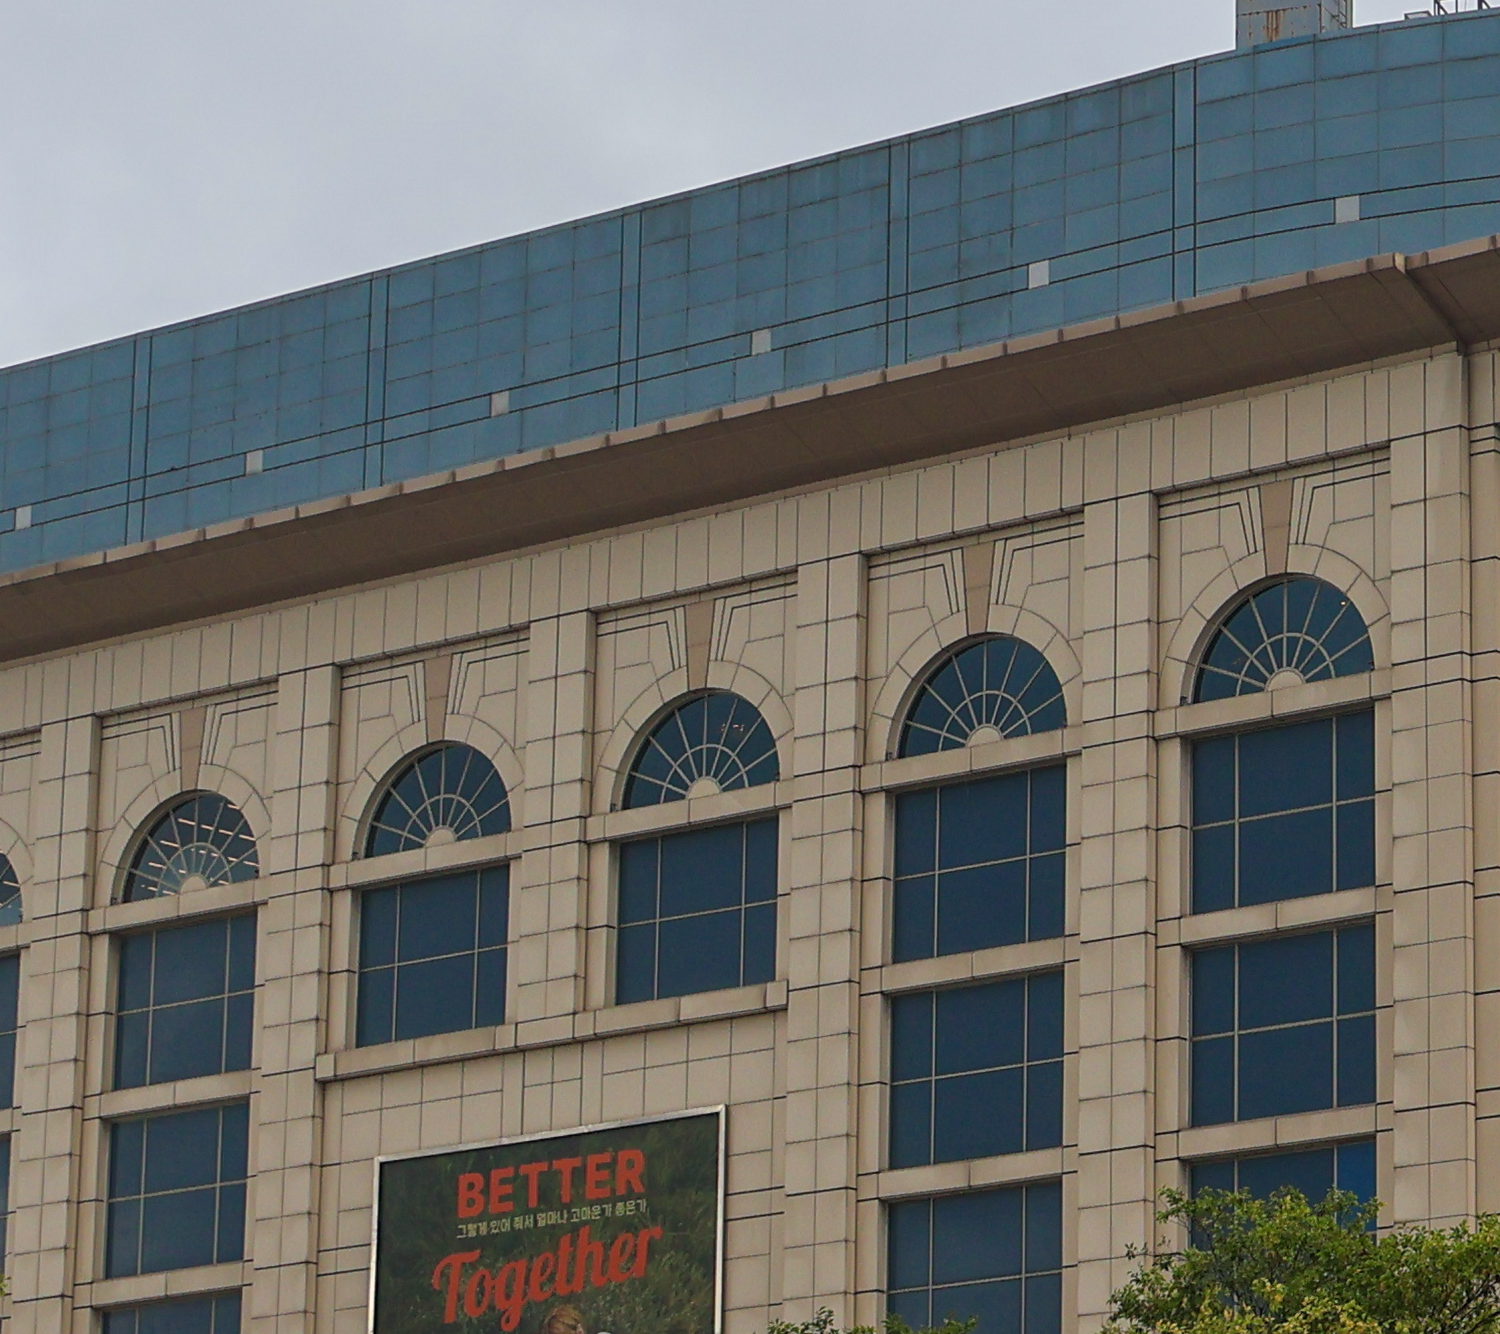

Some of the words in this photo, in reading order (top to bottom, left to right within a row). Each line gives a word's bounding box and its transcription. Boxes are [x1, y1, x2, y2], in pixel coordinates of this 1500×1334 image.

[458, 1148, 646, 1218] BETTER
[536, 1208, 569, 1228] 얼마나
[570, 1203, 612, 1223] 고마운가
[431, 1226, 663, 1333] Together
